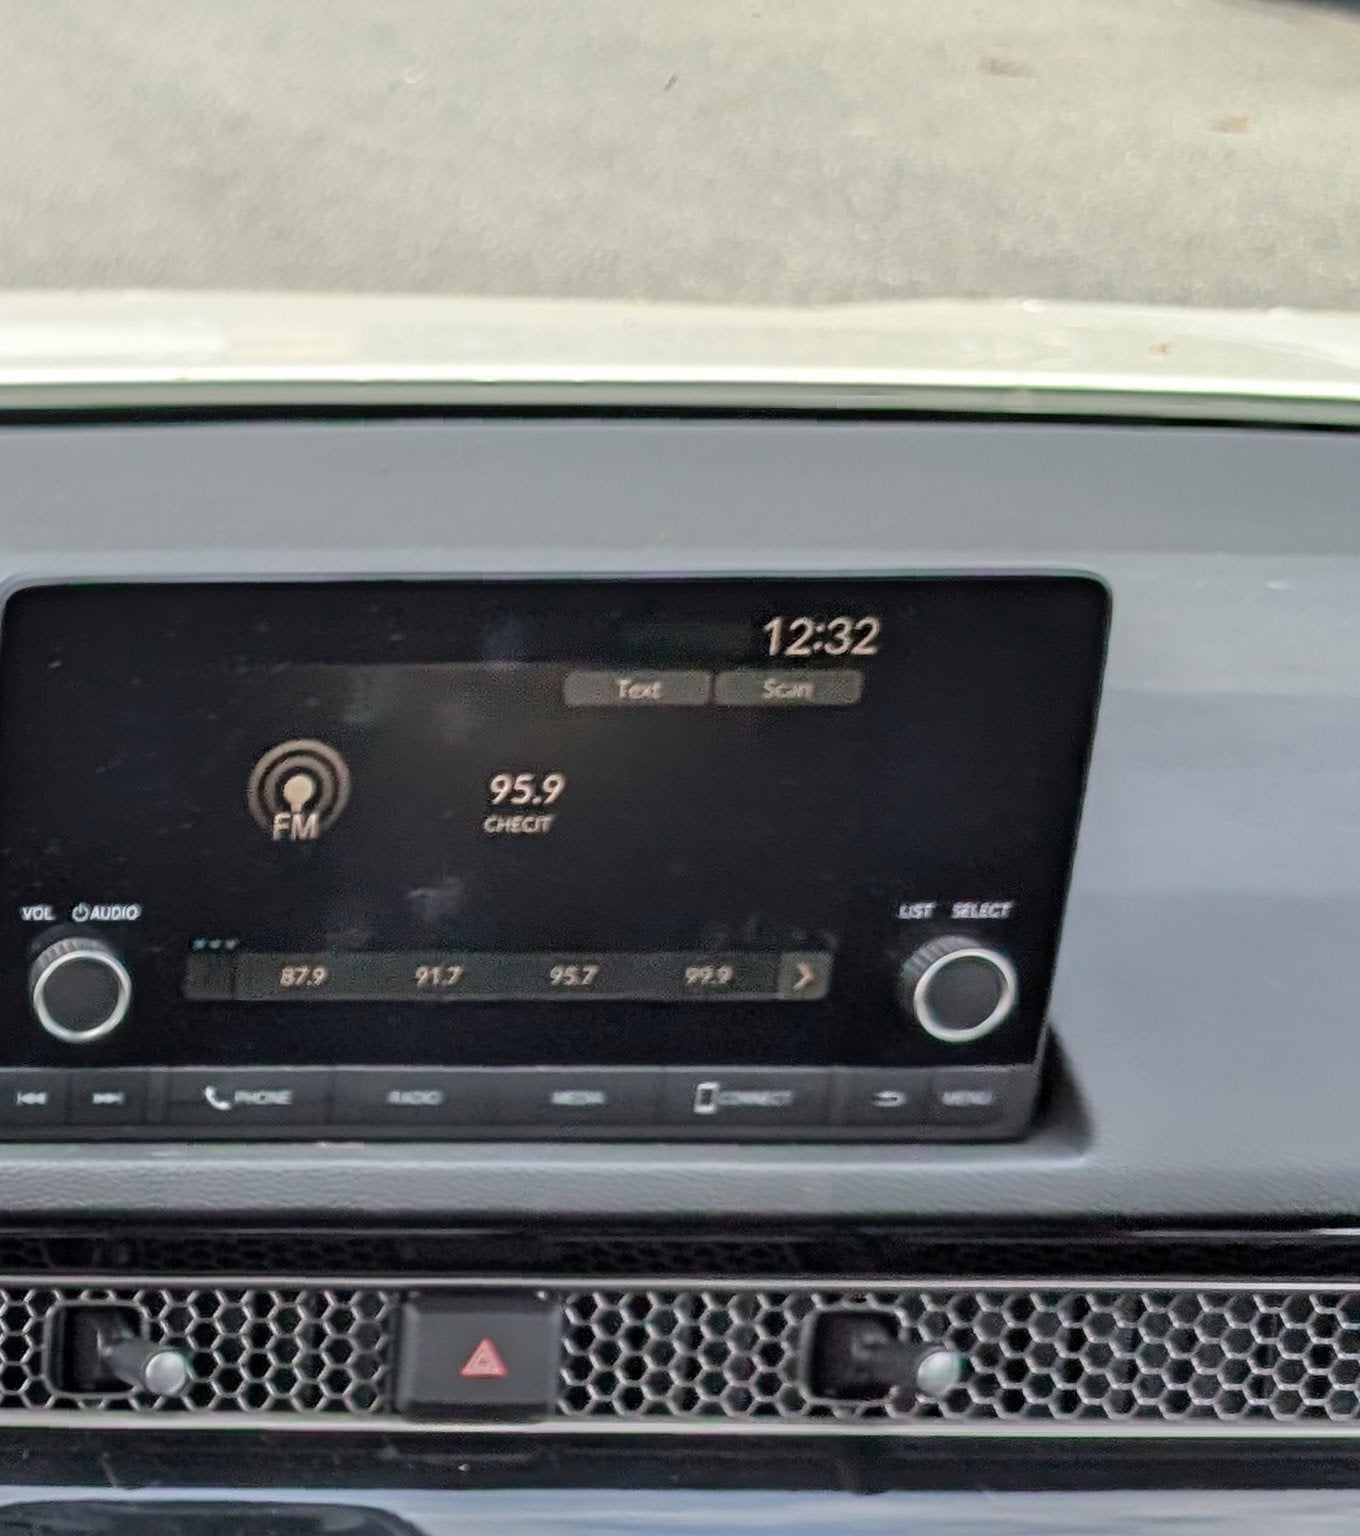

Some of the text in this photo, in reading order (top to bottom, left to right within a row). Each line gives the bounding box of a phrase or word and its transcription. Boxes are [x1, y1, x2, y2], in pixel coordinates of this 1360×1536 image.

[764, 616, 880, 656] 12:32
[490, 772, 566, 805] 95.9
[273, 811, 319, 840] FM
[21, 903, 140, 921] VOL AUDIO
[951, 900, 1014, 920] SELECT
[280, 965, 328, 987] 87.9
